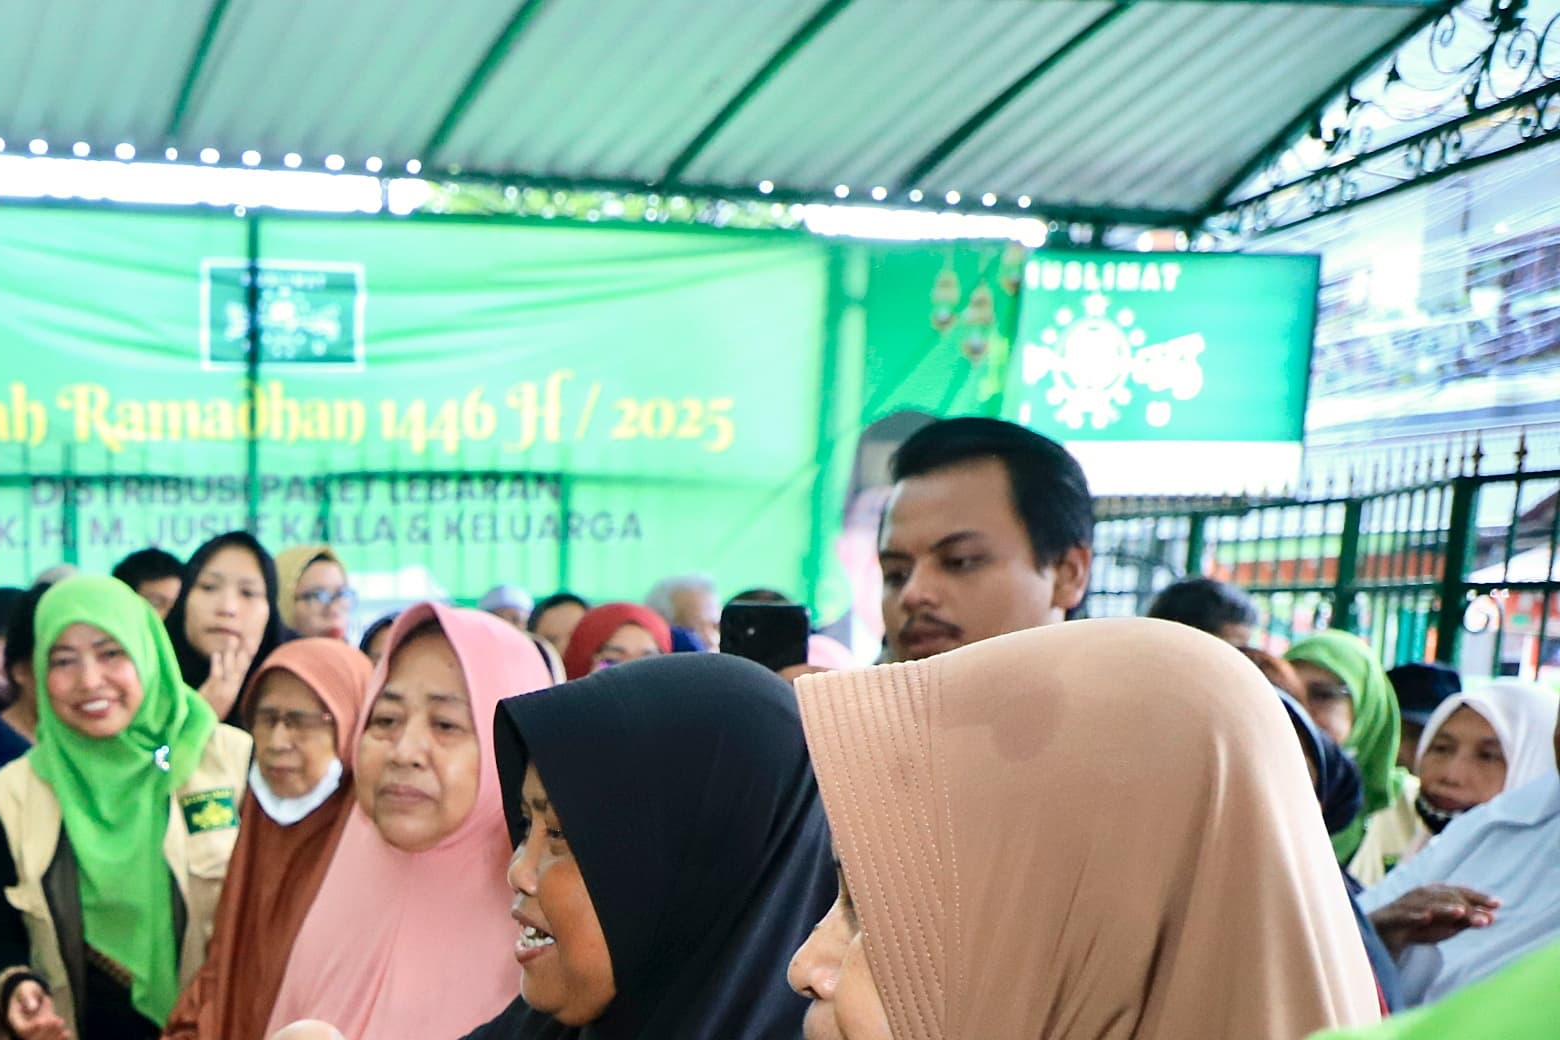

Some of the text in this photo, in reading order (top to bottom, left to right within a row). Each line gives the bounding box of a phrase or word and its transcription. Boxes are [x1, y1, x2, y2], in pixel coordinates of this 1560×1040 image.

[56, 377, 366, 453] Ramadhan
[380, 384, 498, 454] 1446
[502, 367, 576, 452] H
[575, 382, 602, 440] /
[610, 396, 735, 453] 2025
[32, 473, 562, 506] DISTRIBUSI PAKET LEBARAN
[89, 515, 134, 547] M.
[281, 512, 397, 547] KALLA
[407, 513, 431, 545] &
[443, 510, 643, 546] KELUARGA
